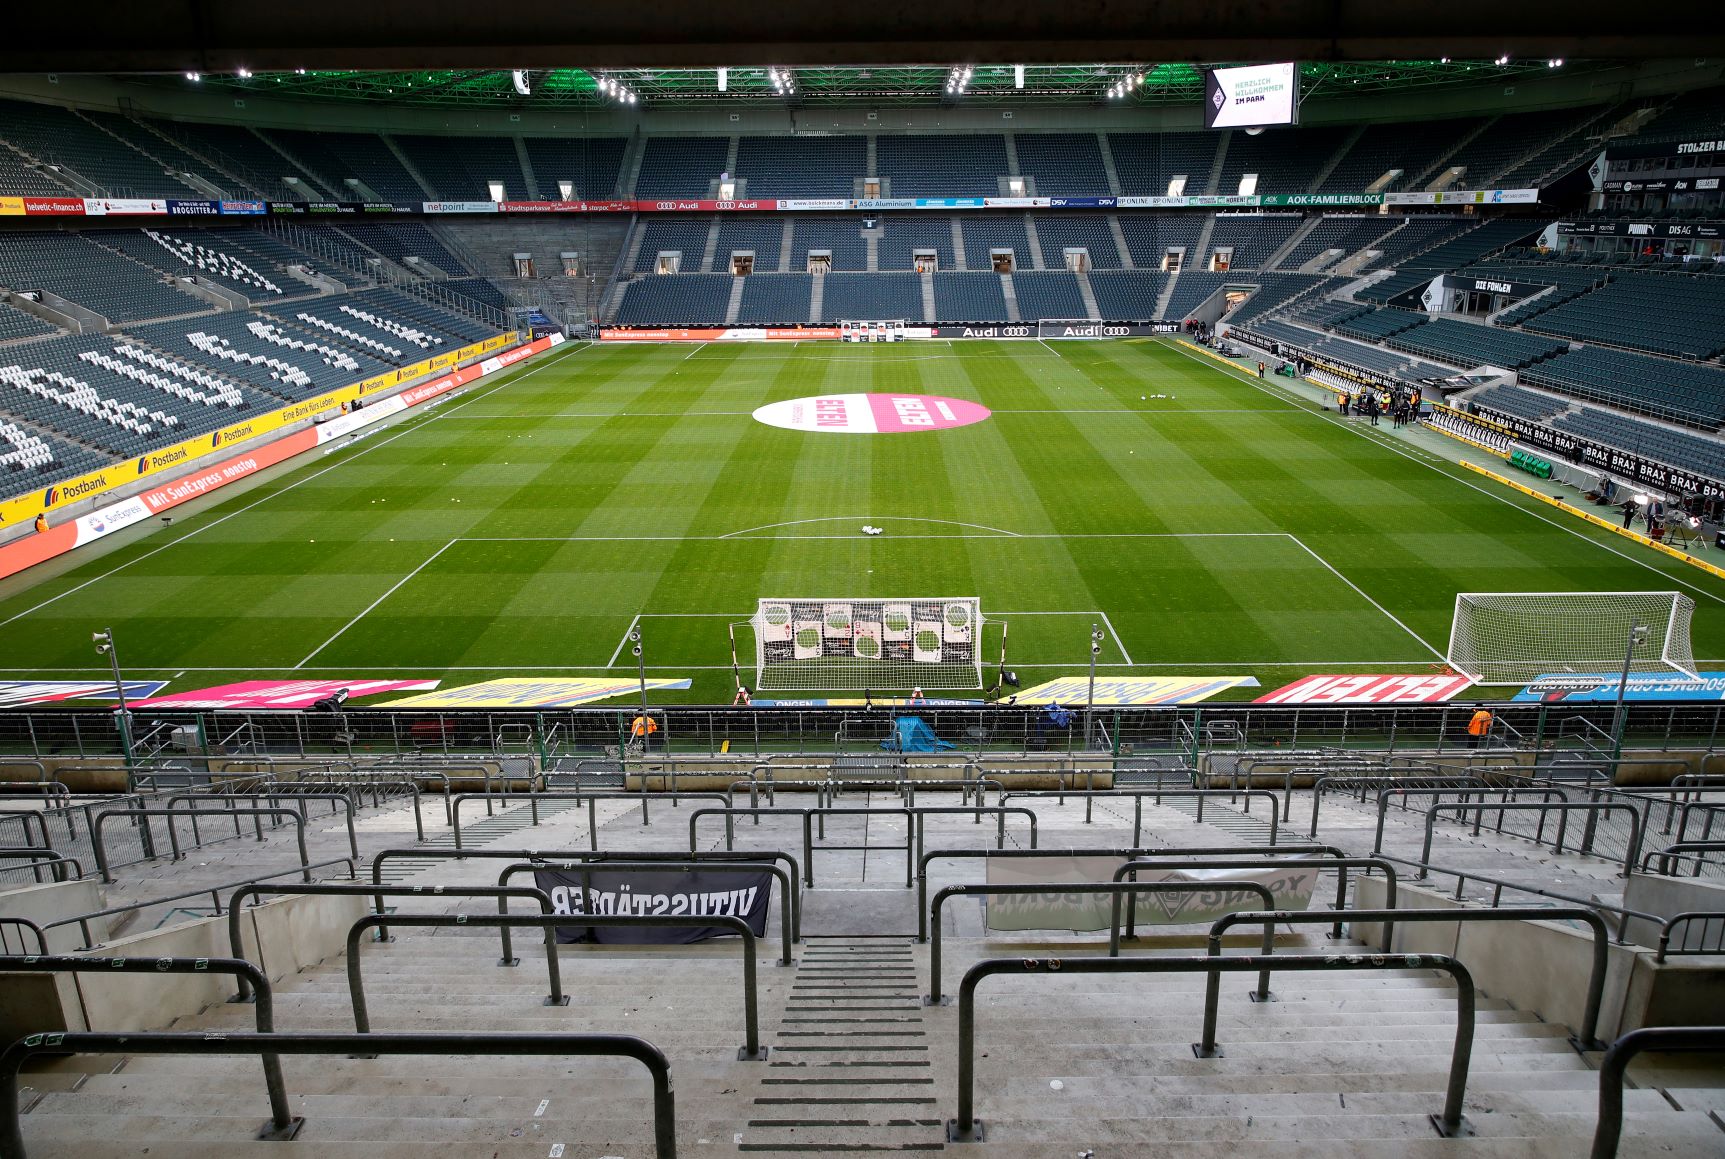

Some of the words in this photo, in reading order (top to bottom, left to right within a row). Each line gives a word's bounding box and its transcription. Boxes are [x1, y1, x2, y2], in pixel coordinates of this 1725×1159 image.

[1235, 78, 1271, 89] HERZLICH
[1235, 84, 1284, 97] WILLKOMMEN
[1246, 95, 1265, 103] PARK
[1677, 141, 1715, 154] STOLZER
[1287, 195, 1381, 204] AOK-FAMILIENBLOCK
[26, 202, 83, 212] helvetic-finance.ch
[428, 203, 464, 212] netpoint
[1628, 224, 1648, 234] PUMA
[1475, 280, 1486, 290] DIE
[1486, 281, 1512, 294] FOHLEN
[962, 327, 998, 338] Audi
[1063, 326, 1099, 336] Audi
[366, 378, 384, 392] Postbank
[282, 412, 294, 422] Eine
[295, 408, 308, 416] Bank
[320, 397, 335, 408] Leben
[1479, 412, 1494, 422] BRAX
[1496, 416, 1514, 428] BRAX
[224, 424, 253, 443] Postbank
[1514, 423, 1532, 436] BRAX
[1534, 430, 1554, 443] BRAX
[1555, 437, 1576, 450] BRAX
[152, 446, 188, 468] Postbank
[1586, 447, 1608, 462] BRAX
[1612, 456, 1636, 470] BRAX
[1640, 464, 1666, 481] BRAX
[62, 475, 106, 500] Postbank
[147, 488, 166, 508] Mit
[167, 471, 222, 502] SunExpress
[222, 457, 257, 478] nonstop
[1670, 474, 1699, 492] BRAX
[105, 504, 142, 524] SunExpress
[1264, 676, 1461, 703] ELTEN
